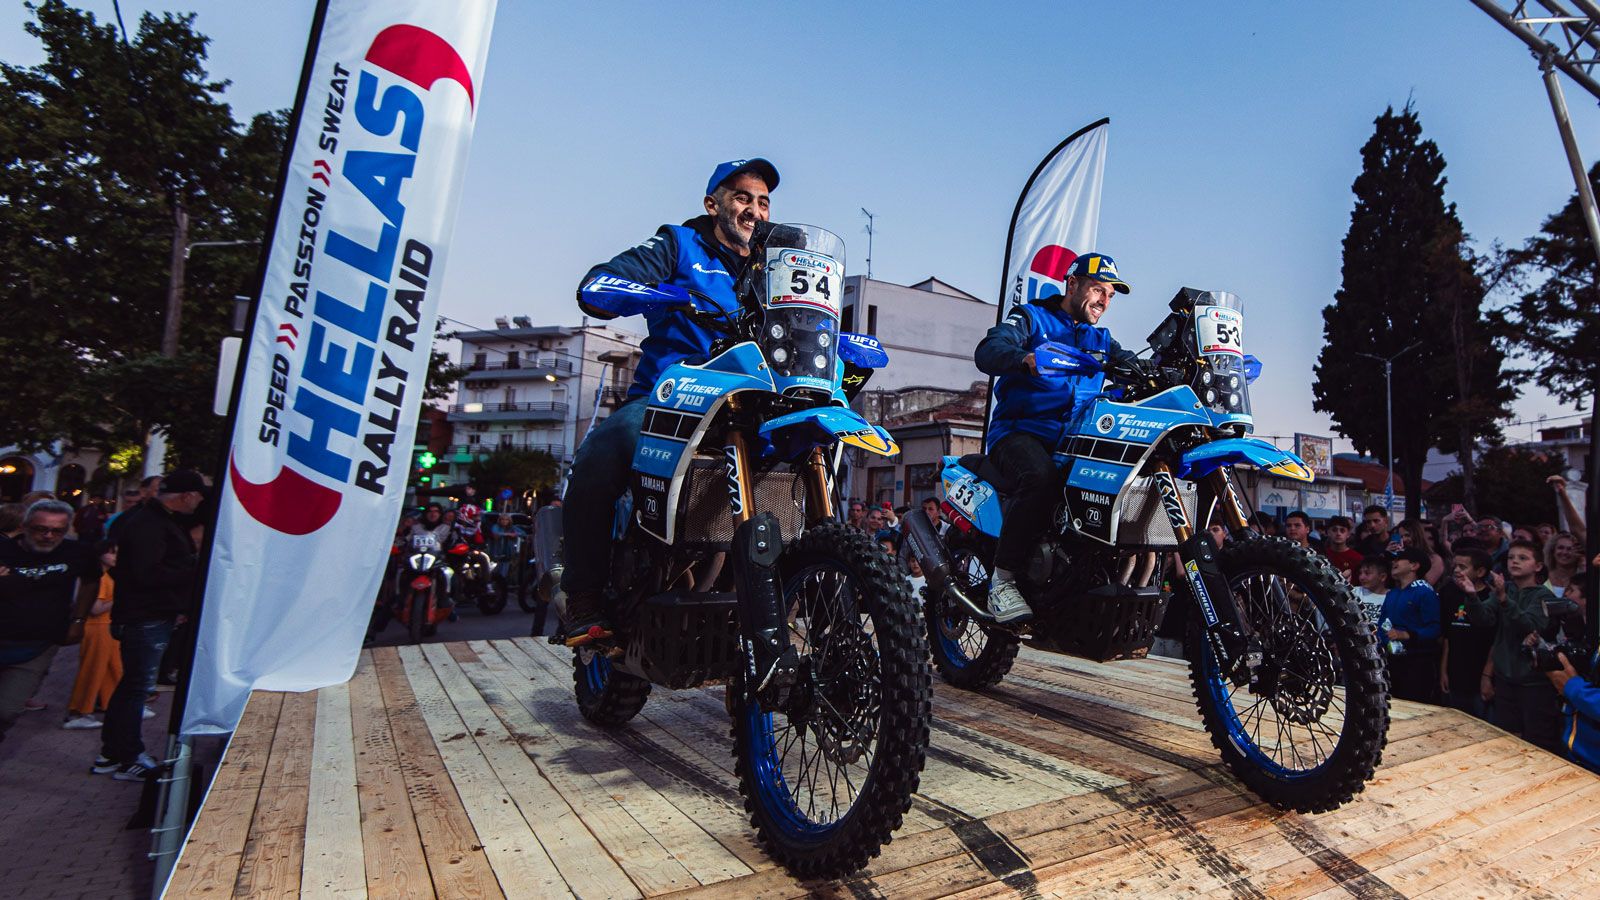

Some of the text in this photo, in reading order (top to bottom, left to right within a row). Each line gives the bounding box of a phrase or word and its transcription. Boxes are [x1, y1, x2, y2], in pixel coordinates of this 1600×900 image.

[259, 62, 352, 448] SPEED PASSION SWEAT
[796, 257, 827, 269] HELLAS
[286, 69, 425, 484] HELLAS
[596, 276, 640, 291] UFO
[790, 269, 831, 300] 54
[849, 335, 879, 348] UFO
[1216, 323, 1241, 348] 53
[354, 238, 434, 496] RALLY RAID
[674, 393, 706, 409] 700
[1117, 426, 1151, 440] 700
[640, 446, 672, 460] GYTR
[1079, 467, 1118, 480] GYTR
[641, 476, 666, 493] YAMAHA
[955, 484, 975, 506] 53
[1080, 490, 1111, 506] YAMAHA
[647, 498, 657, 513] 70
[1088, 509, 1100, 521] 70
[1195, 580, 1216, 623] MICHELIN
